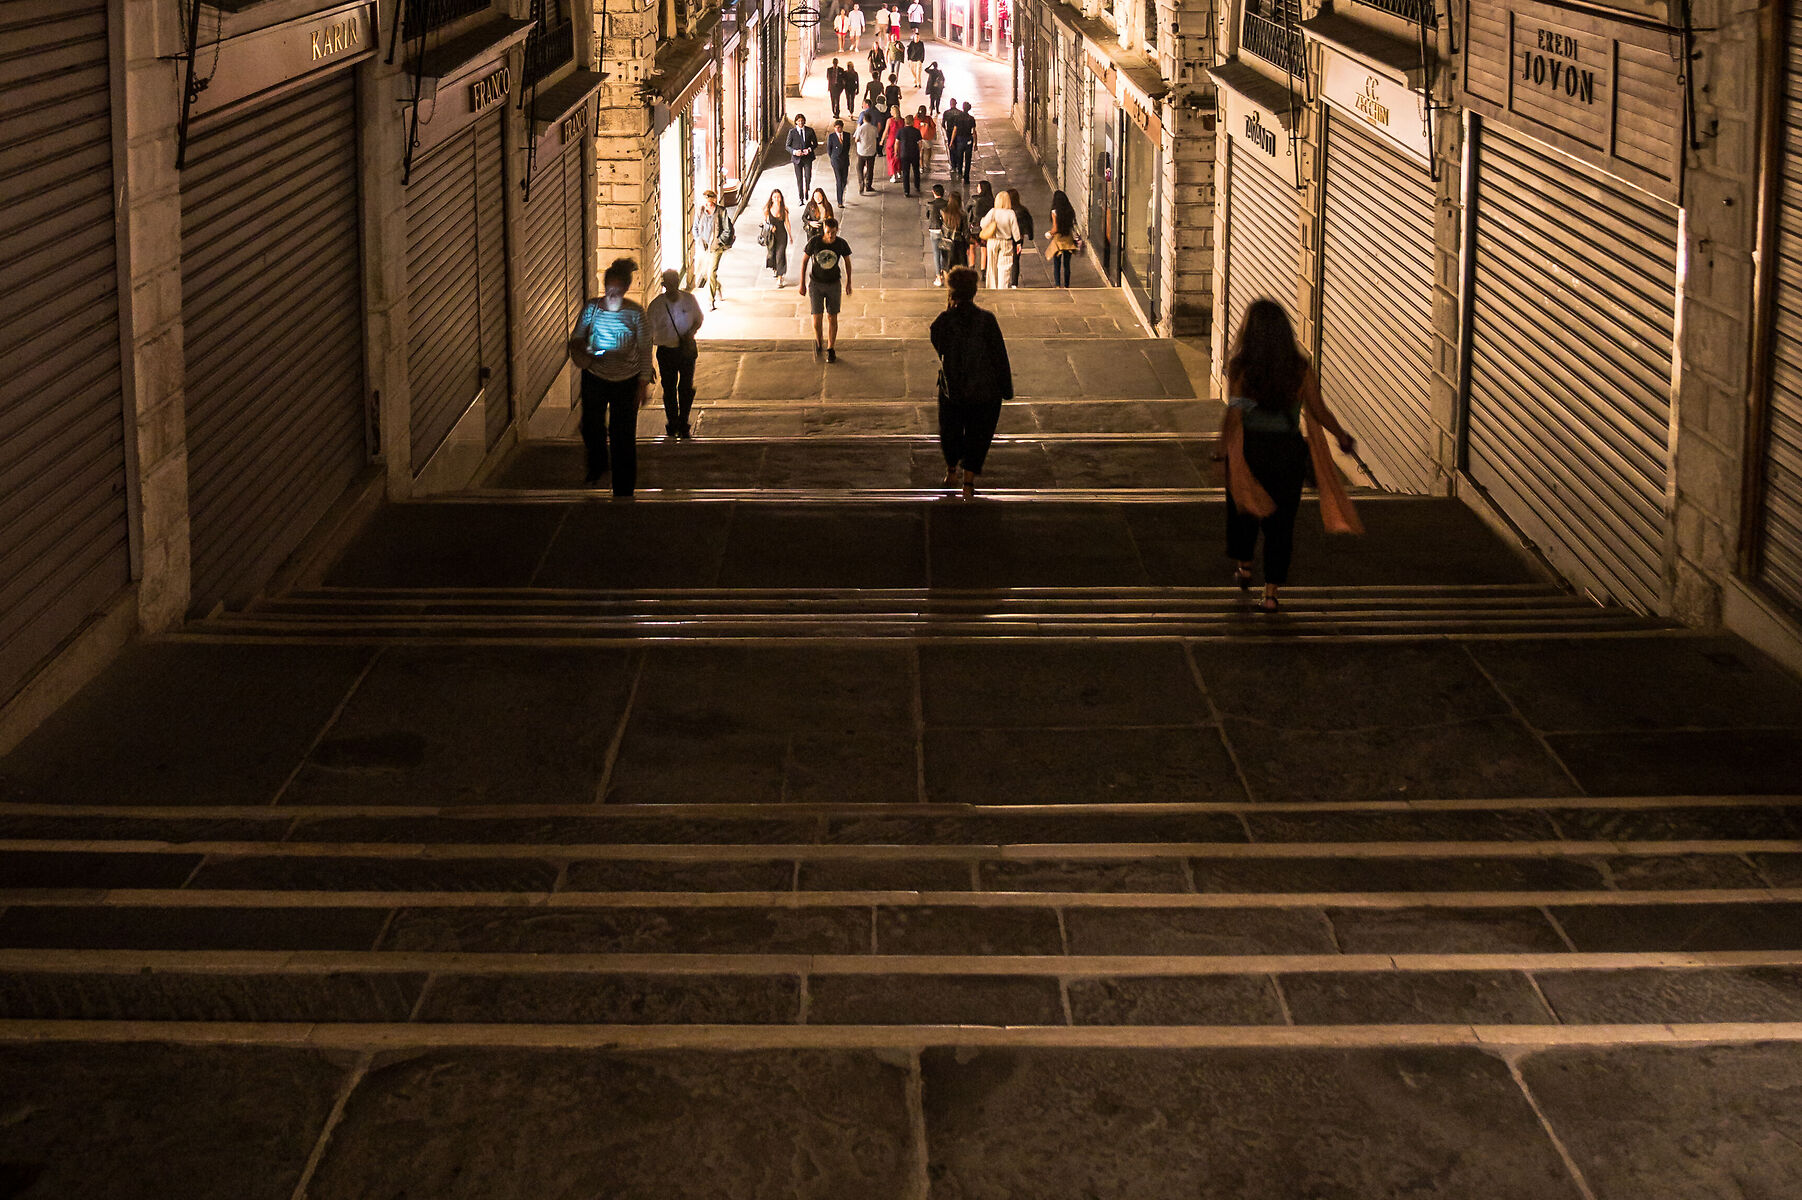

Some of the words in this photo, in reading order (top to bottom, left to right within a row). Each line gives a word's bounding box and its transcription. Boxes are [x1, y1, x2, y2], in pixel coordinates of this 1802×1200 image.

[310, 17, 359, 60] KARIN
[1537, 29, 1578, 60] EREDI
[473, 67, 511, 113] FRANCO
[1522, 52, 1594, 104] JOVON
